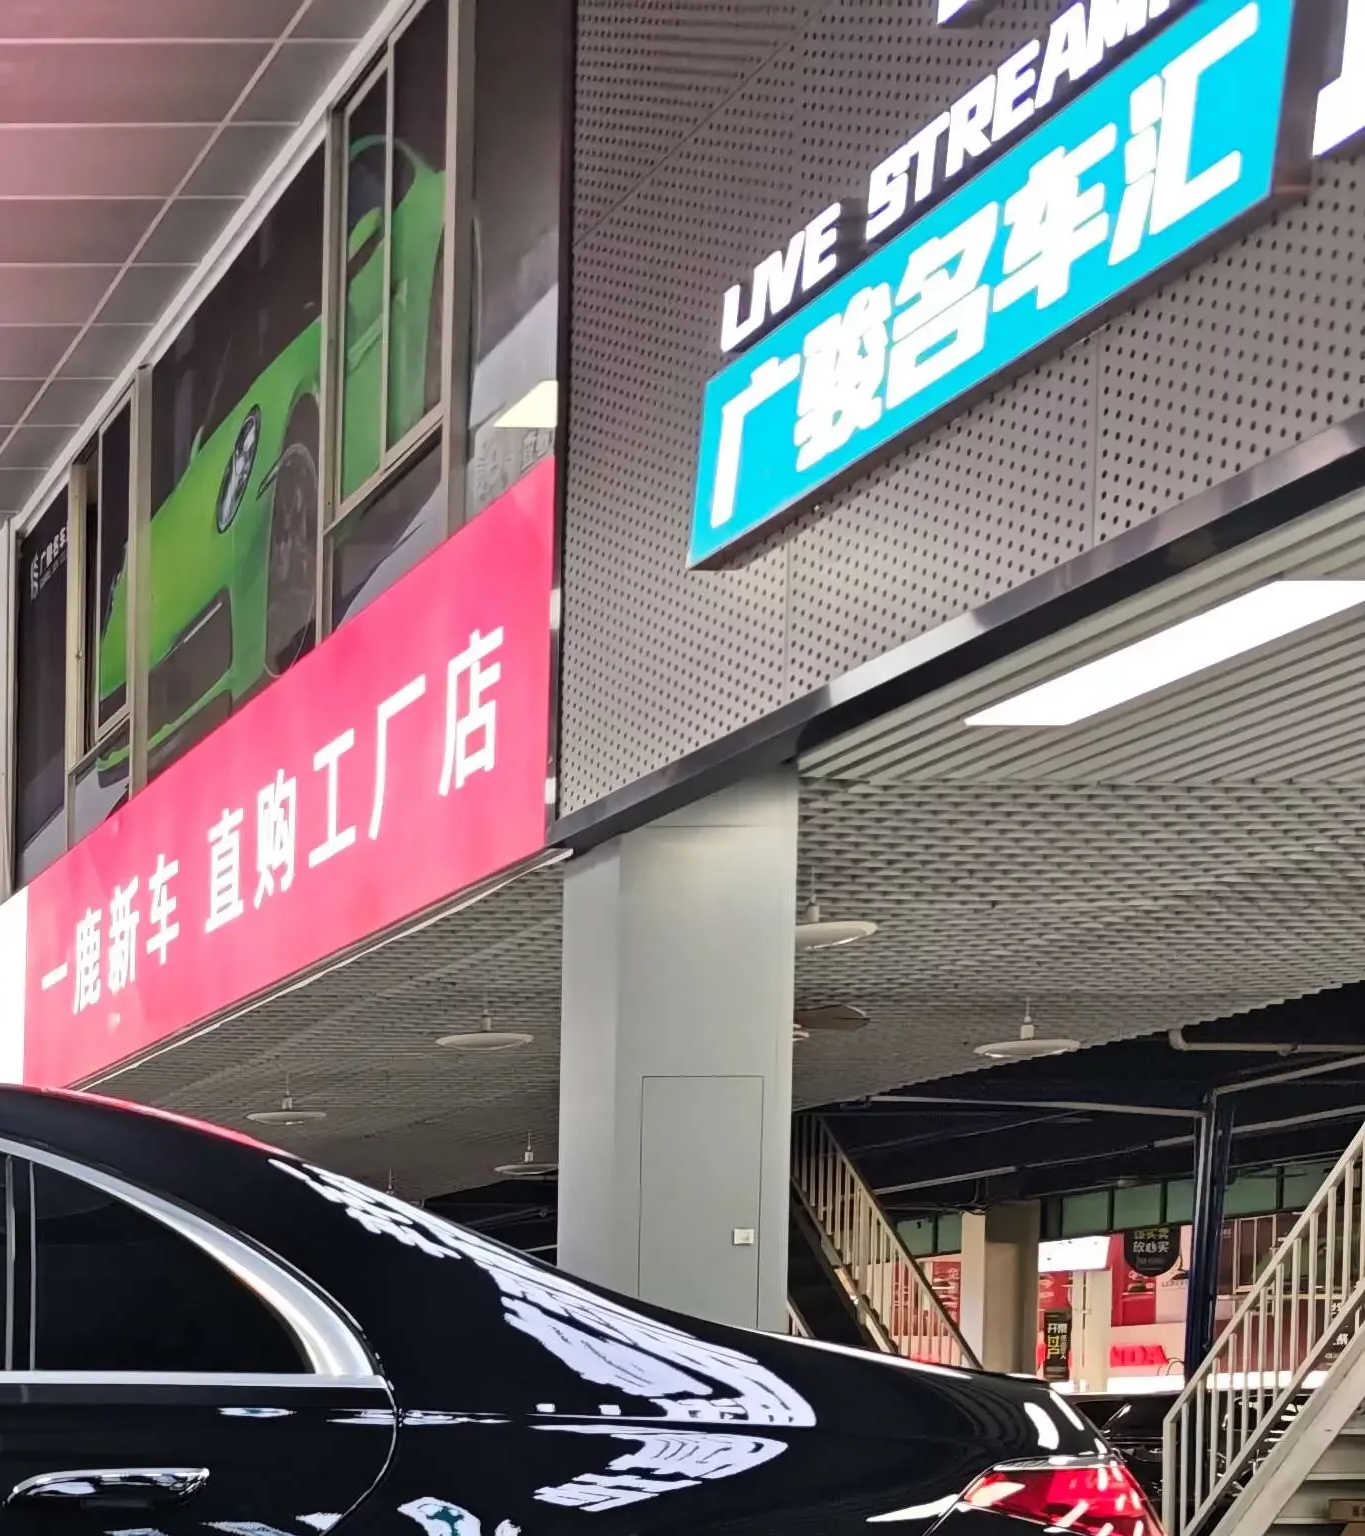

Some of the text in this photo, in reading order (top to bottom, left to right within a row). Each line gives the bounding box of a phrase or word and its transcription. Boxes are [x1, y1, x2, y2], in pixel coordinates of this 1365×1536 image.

[710, 2, 1260, 530] 广骏名车汇
[721, 202, 842, 354] LIVE
[866, 0, 1171, 241] STREAM
[42, 626, 505, 1016] 一鹿新车 直购工厂店
